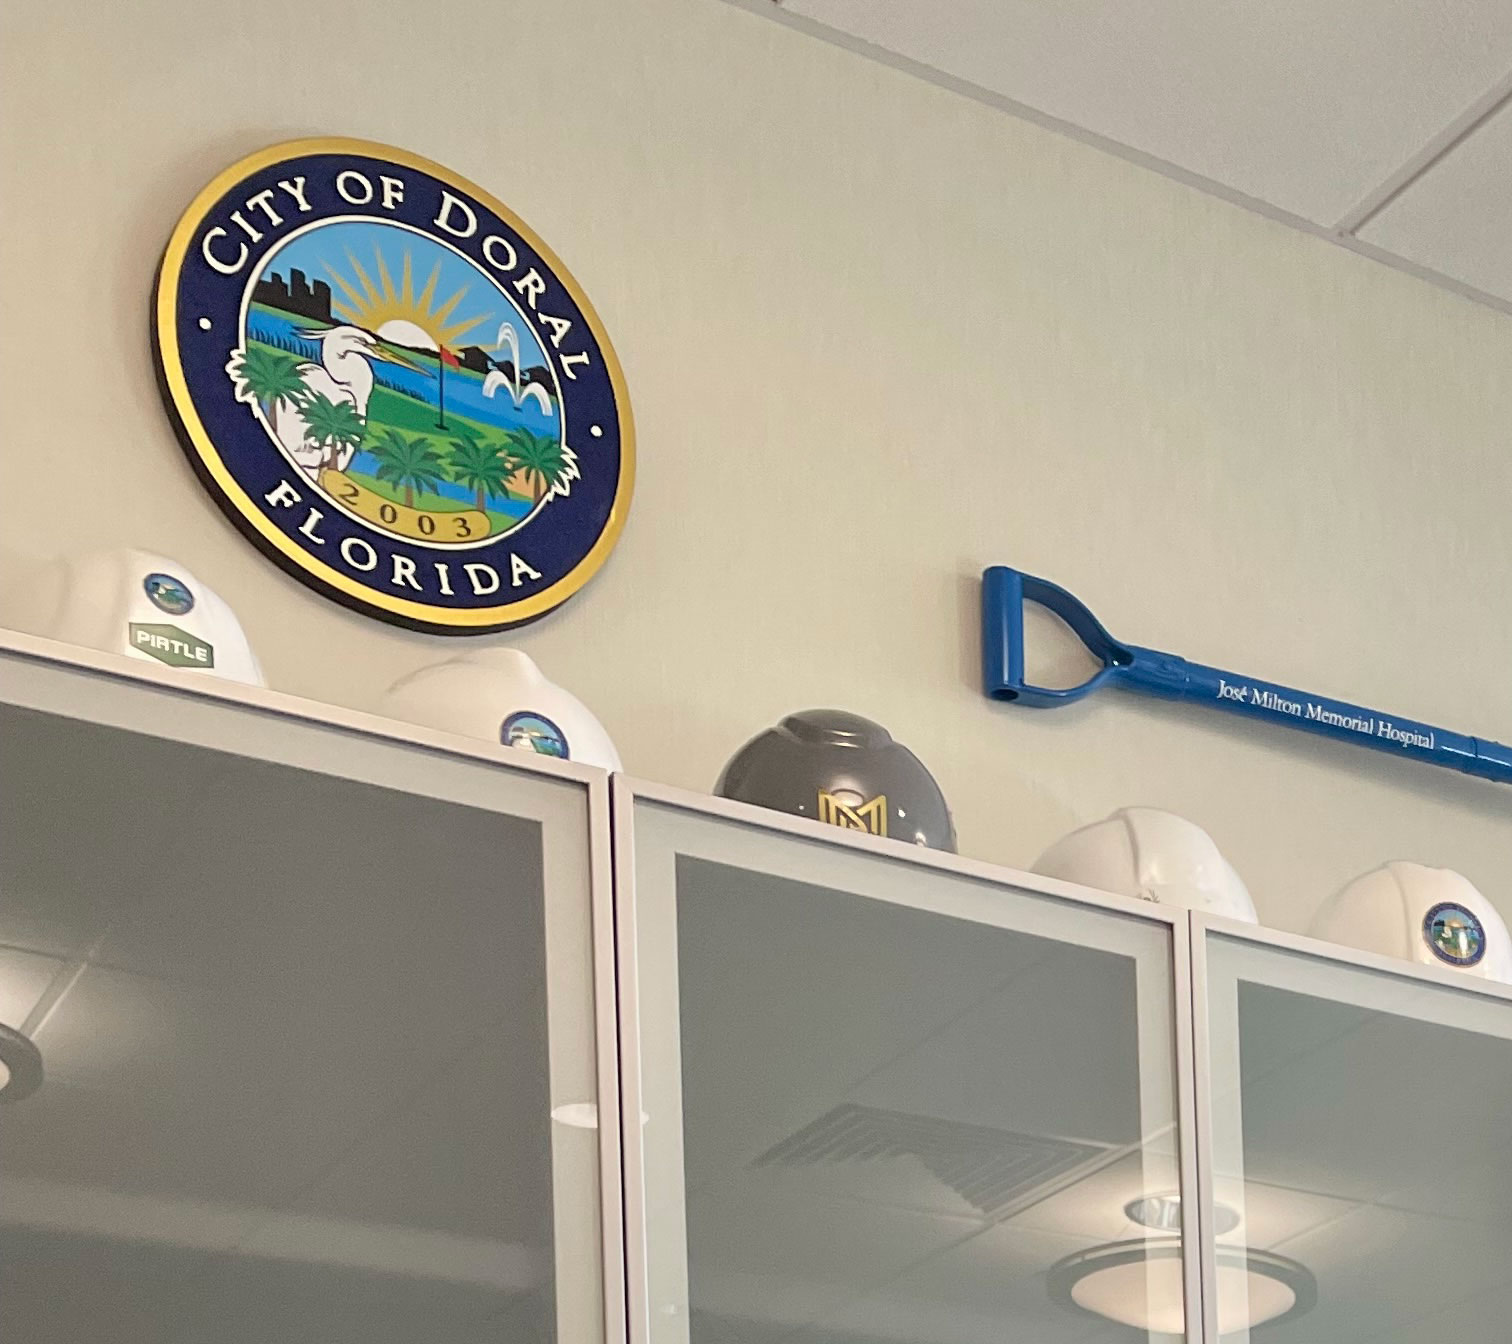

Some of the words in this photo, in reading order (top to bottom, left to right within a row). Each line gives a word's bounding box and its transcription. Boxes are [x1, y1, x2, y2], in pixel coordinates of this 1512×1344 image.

[201, 176, 312, 276] CITY
[335, 170, 405, 209] OF
[434, 190, 591, 381] DORAL
[263, 478, 542, 597] FLORIDA
[338, 482, 473, 539] 2003
[136, 629, 208, 662] PIRTLE
[1216, 679, 1248, 703] José
[1250, 688, 1301, 717] Milton
[1303, 702, 1375, 735] Memorial
[1377, 720, 1434, 750] Hospital
